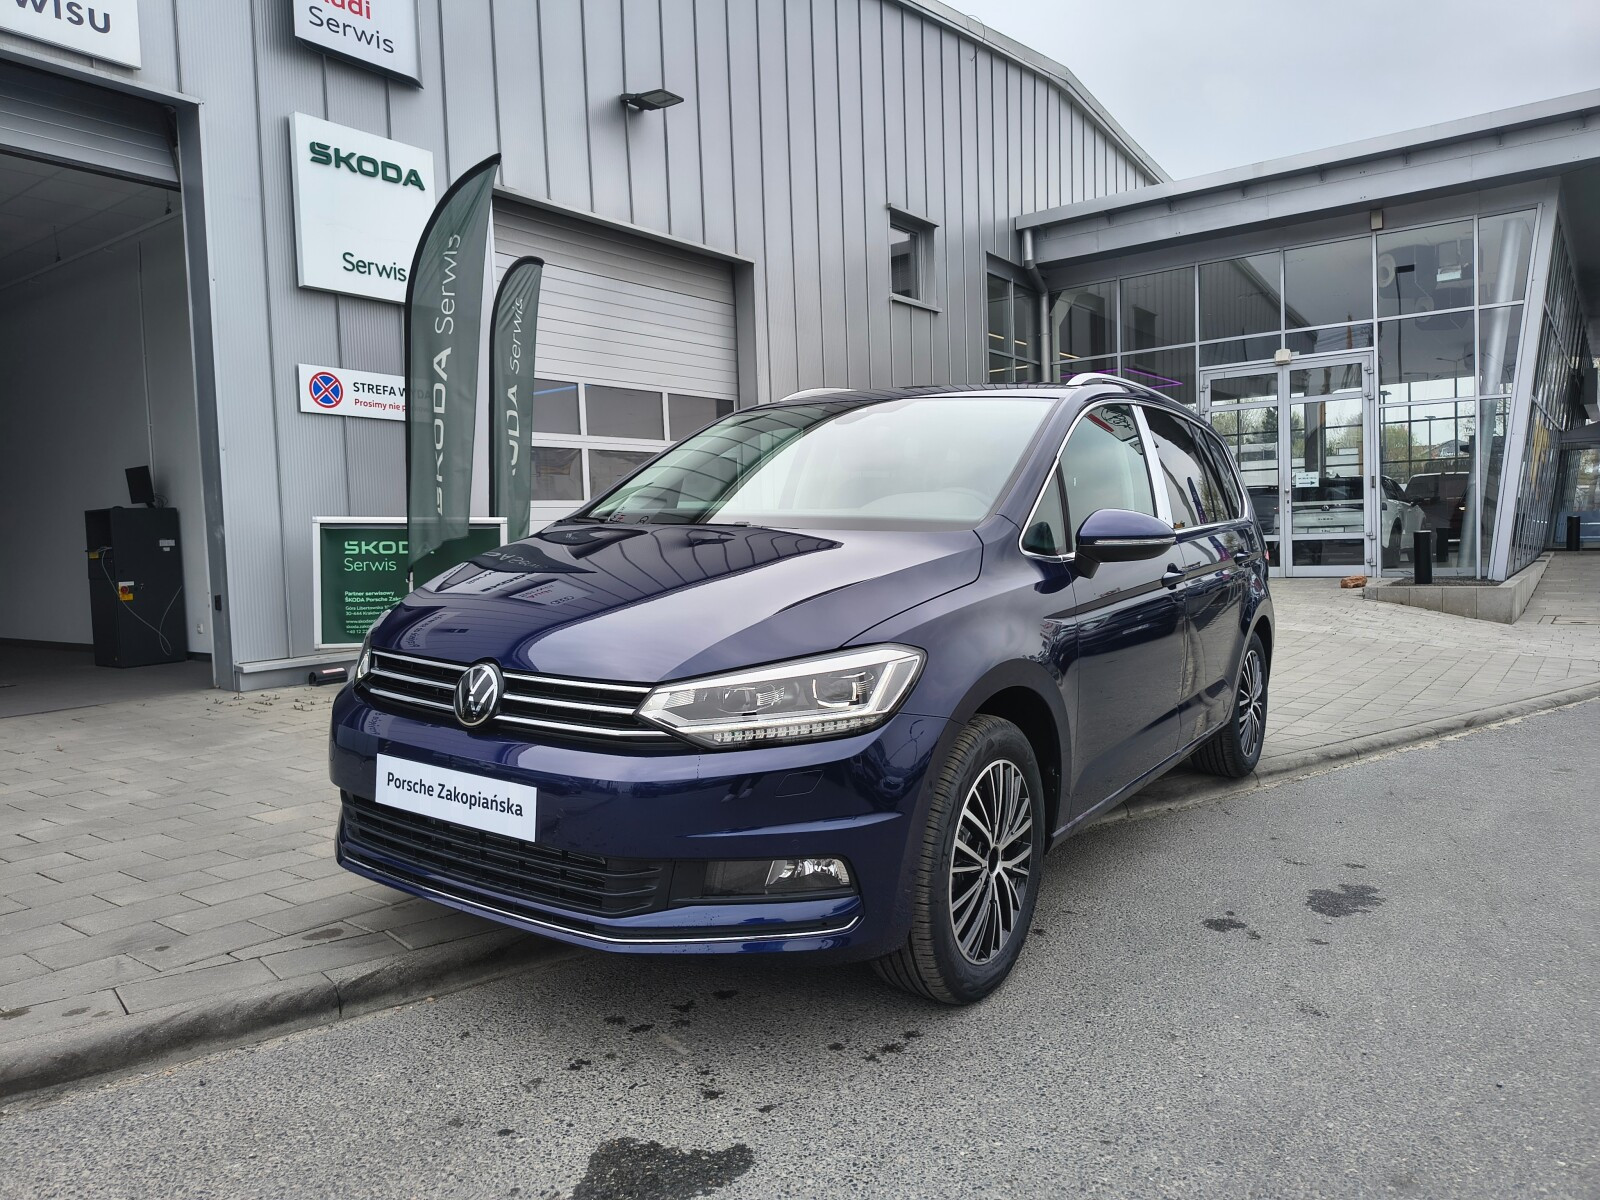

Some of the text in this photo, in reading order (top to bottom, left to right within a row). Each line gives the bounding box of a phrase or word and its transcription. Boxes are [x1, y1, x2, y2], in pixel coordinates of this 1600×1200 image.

[323, 0, 371, 20] udi
[308, 5, 395, 54] Serwis
[342, 251, 407, 282] Serwis
[434, 234, 461, 335] Serwis
[353, 381, 396, 397] STREFA
[354, 398, 400, 411] Prosimy nie
[344, 557, 397, 572] Serwis
[387, 772, 524, 817] Porsche Zakopiańska
